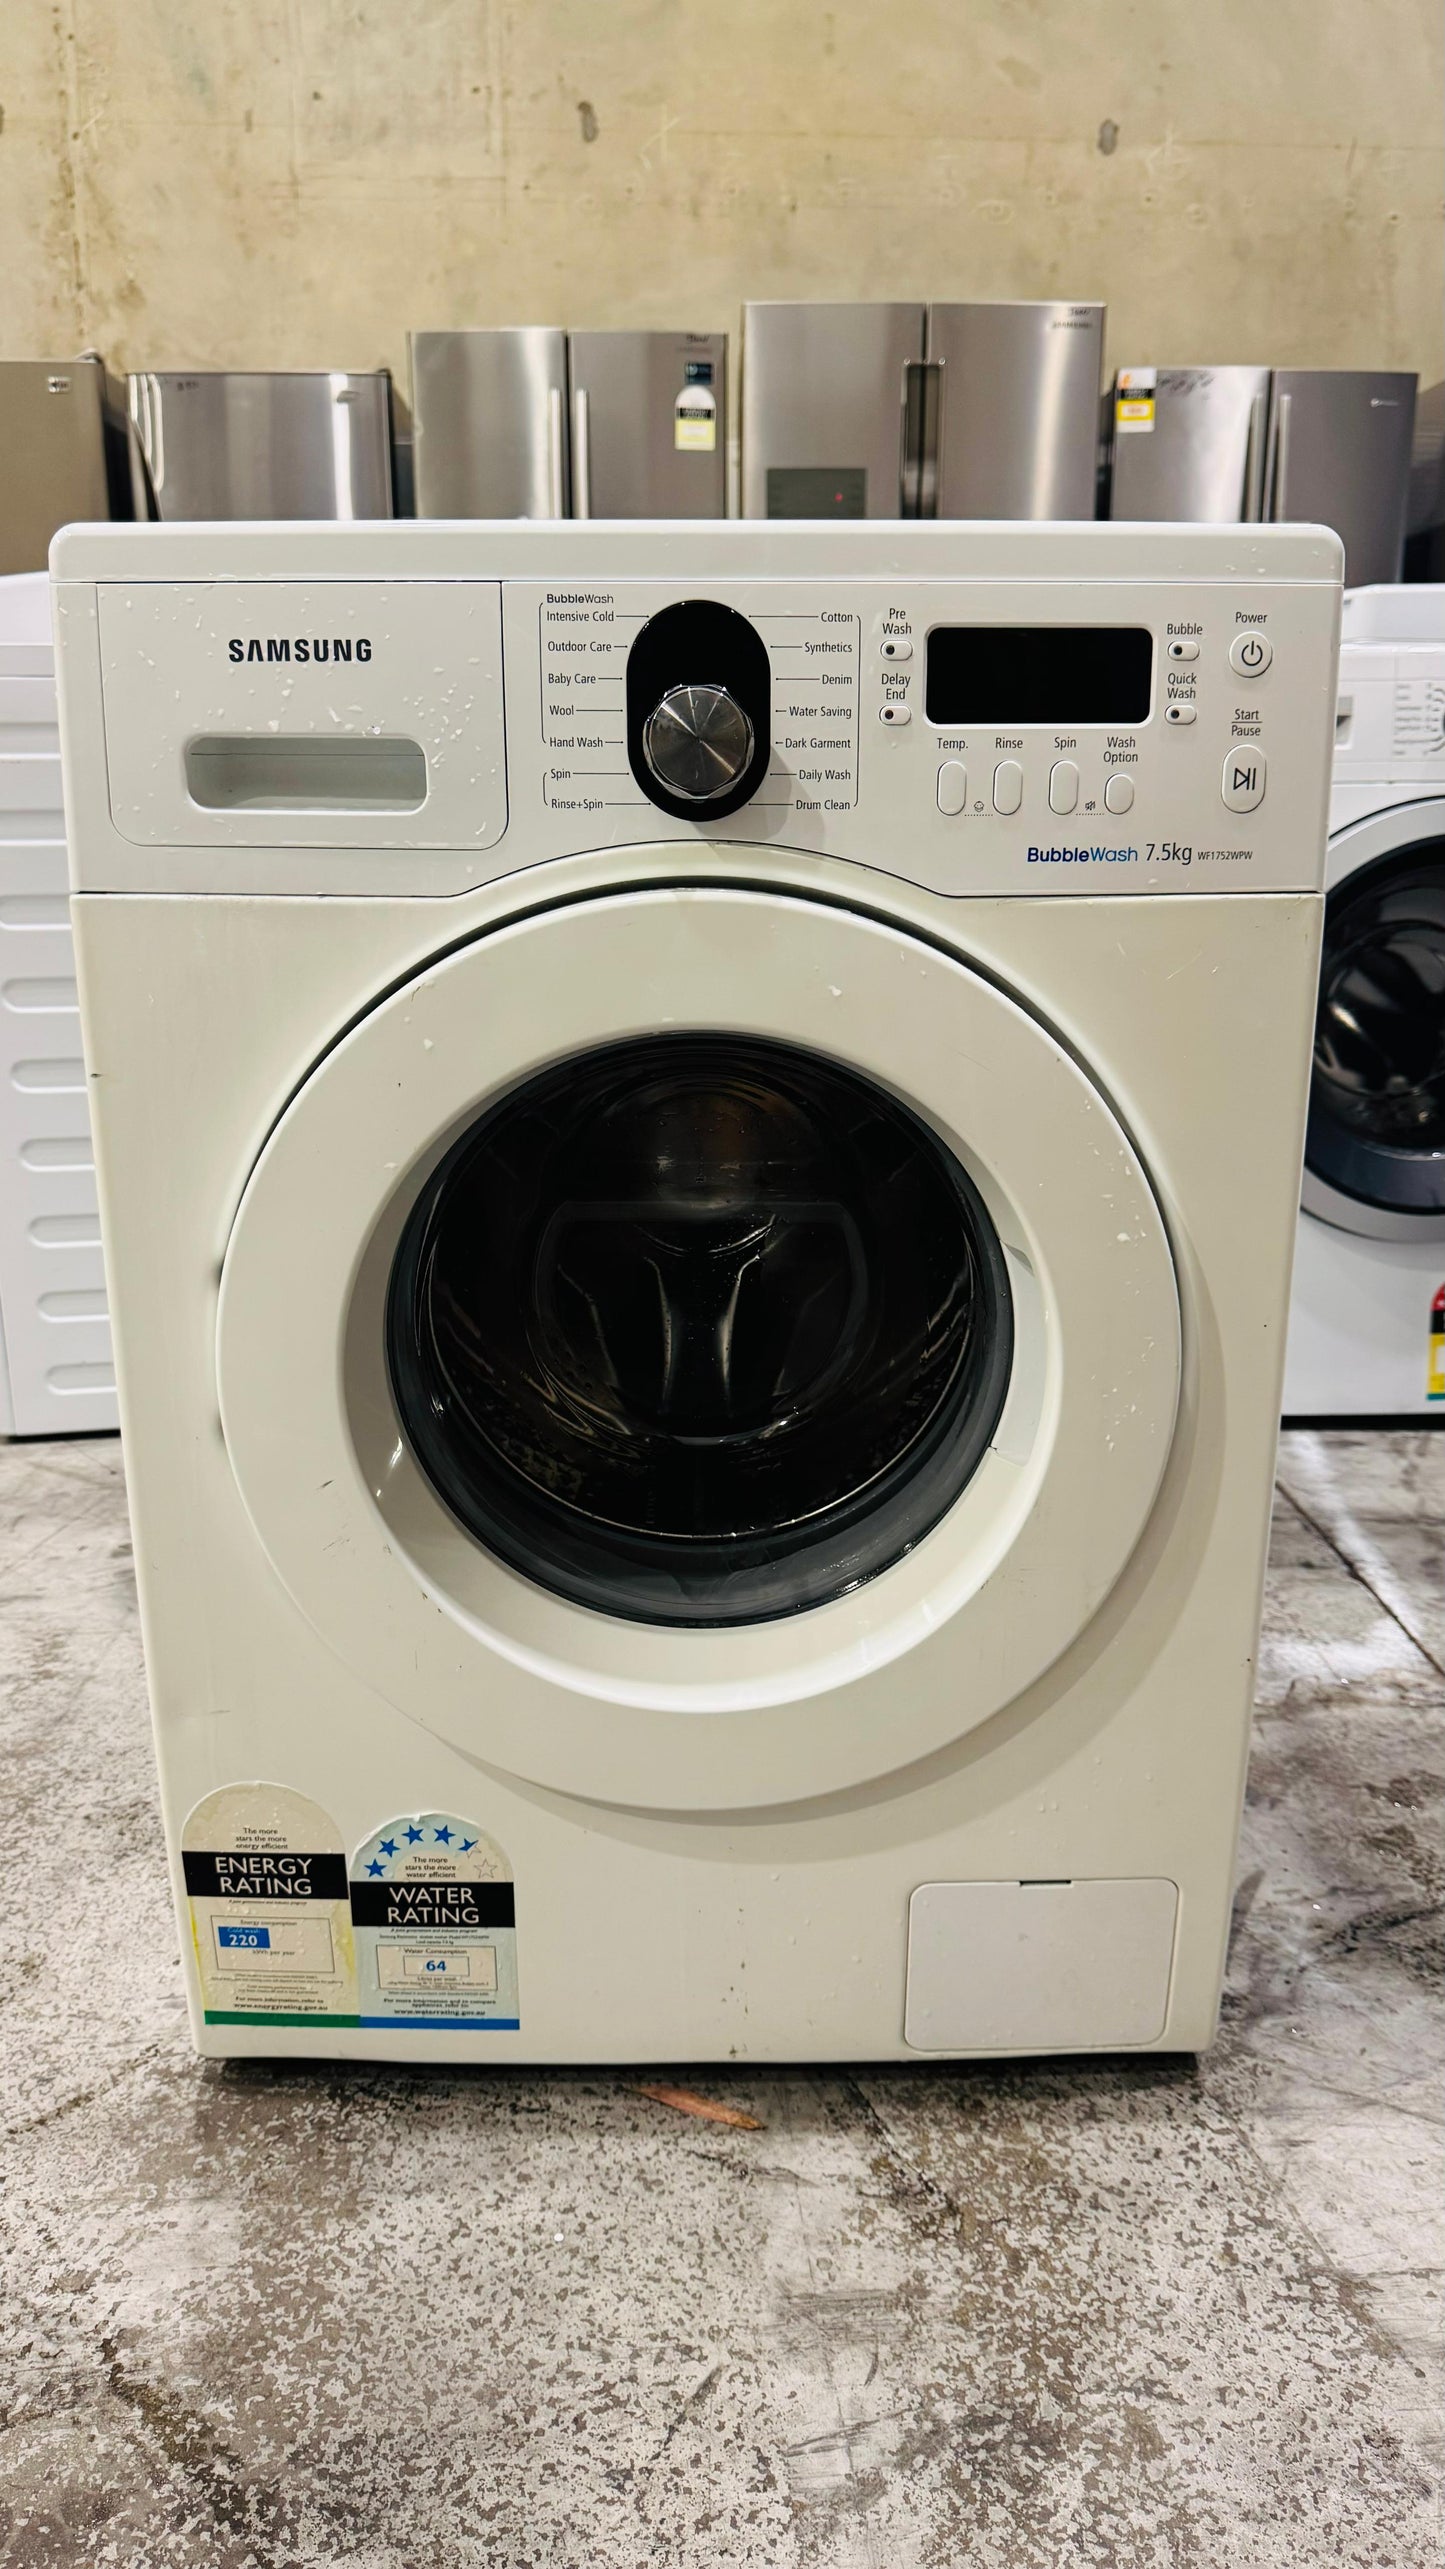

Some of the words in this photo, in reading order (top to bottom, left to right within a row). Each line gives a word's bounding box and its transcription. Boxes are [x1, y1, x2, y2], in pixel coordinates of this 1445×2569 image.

[546, 594, 613, 604] BubbleWash
[547, 611, 588, 622] Intensive
[593, 611, 614, 622] Cold
[821, 612, 853, 623] Cotton
[889, 608, 906, 620] Pre
[1235, 612, 1267, 624] Power
[882, 623, 912, 635] Wash
[1167, 624, 1202, 636] Bubble
[229, 639, 372, 663] SAMSUNG
[548, 641, 586, 652] Outdoor
[590, 641, 611, 652] Care
[805, 642, 852, 655] Synthetics
[548, 673, 571, 685] Baby
[574, 674, 596, 684] Care
[822, 674, 852, 685] Denim
[881, 674, 911, 688] Delay
[1167, 673, 1196, 686] Quick
[886, 689, 906, 700] End
[1167, 688, 1196, 699] Wash
[550, 705, 574, 716] Wool
[789, 706, 818, 717] Water
[820, 706, 852, 719] Saving
[1235, 709, 1259, 721] Start
[1231, 725, 1261, 737] Pause
[550, 737, 573, 748] Hand
[576, 737, 603, 748] Wash
[785, 737, 806, 748] Dark
[809, 738, 851, 749] Garment
[937, 738, 968, 751] Temp.
[995, 737, 1023, 749] Rinse
[1055, 737, 1076, 751] Spin
[1107, 737, 1135, 748] Wash
[1103, 751, 1138, 764] Option
[551, 768, 571, 781] Spin
[799, 769, 822, 782] Daily
[825, 769, 851, 780] Wash
[551, 799, 603, 811] Rinse+Spin
[796, 799, 821, 810] Drum
[825, 799, 850, 810] Clean
[1027, 847, 1137, 863] BubbleWash
[1146, 843, 1192, 865] 7.5kg
[1198, 851, 1252, 861] WF1752WPW
[215, 1857, 312, 1875] ENERGY
[220, 1877, 312, 1895] RATING
[389, 1888, 475, 1904] WATER
[388, 1907, 479, 1924] RATING
[229, 1935, 257, 1946] 220
[426, 1960, 446, 1971] 64
